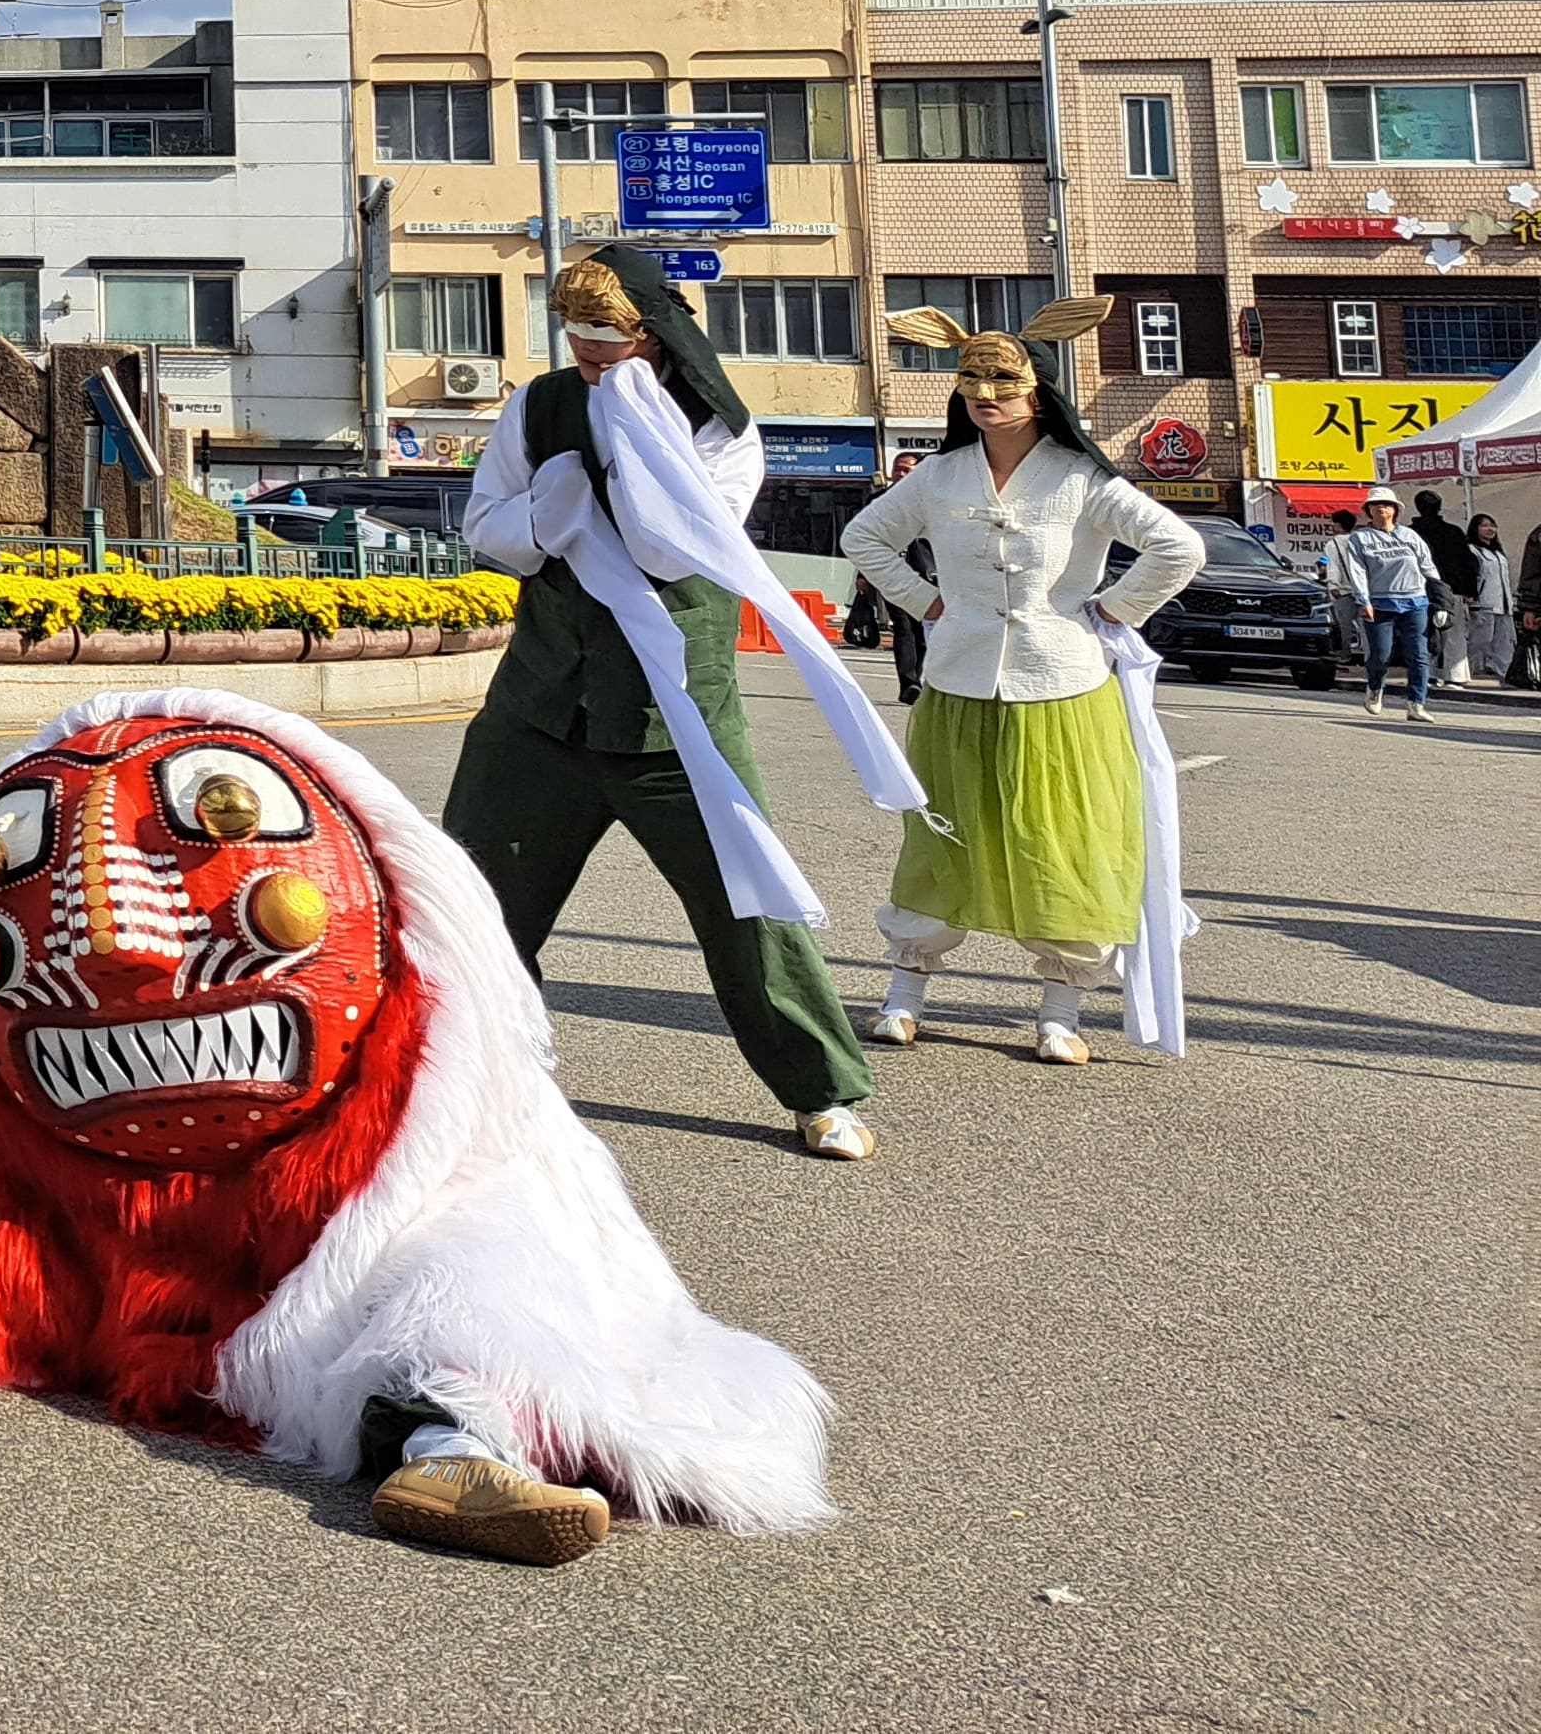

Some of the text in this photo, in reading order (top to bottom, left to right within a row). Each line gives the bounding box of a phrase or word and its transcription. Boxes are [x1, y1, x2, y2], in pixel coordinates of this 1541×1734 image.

[628, 139, 644, 151] 21
[653, 136, 760, 155] 보령 Boryeong
[629, 157, 647, 170] 29
[653, 155, 746, 172] 서산 Seosan
[654, 174, 715, 192] 홍성IC
[630, 185, 648, 197] 15
[656, 193, 753, 206] Hongseong IC
[694, 260, 716, 271] 163
[1313, 397, 1470, 453] 사진
[1157, 426, 1189, 458] 花
[1279, 460, 1302, 471] 조양
[1287, 523, 1334, 536] 여권사진
[1288, 541, 1325, 552] 가족사
